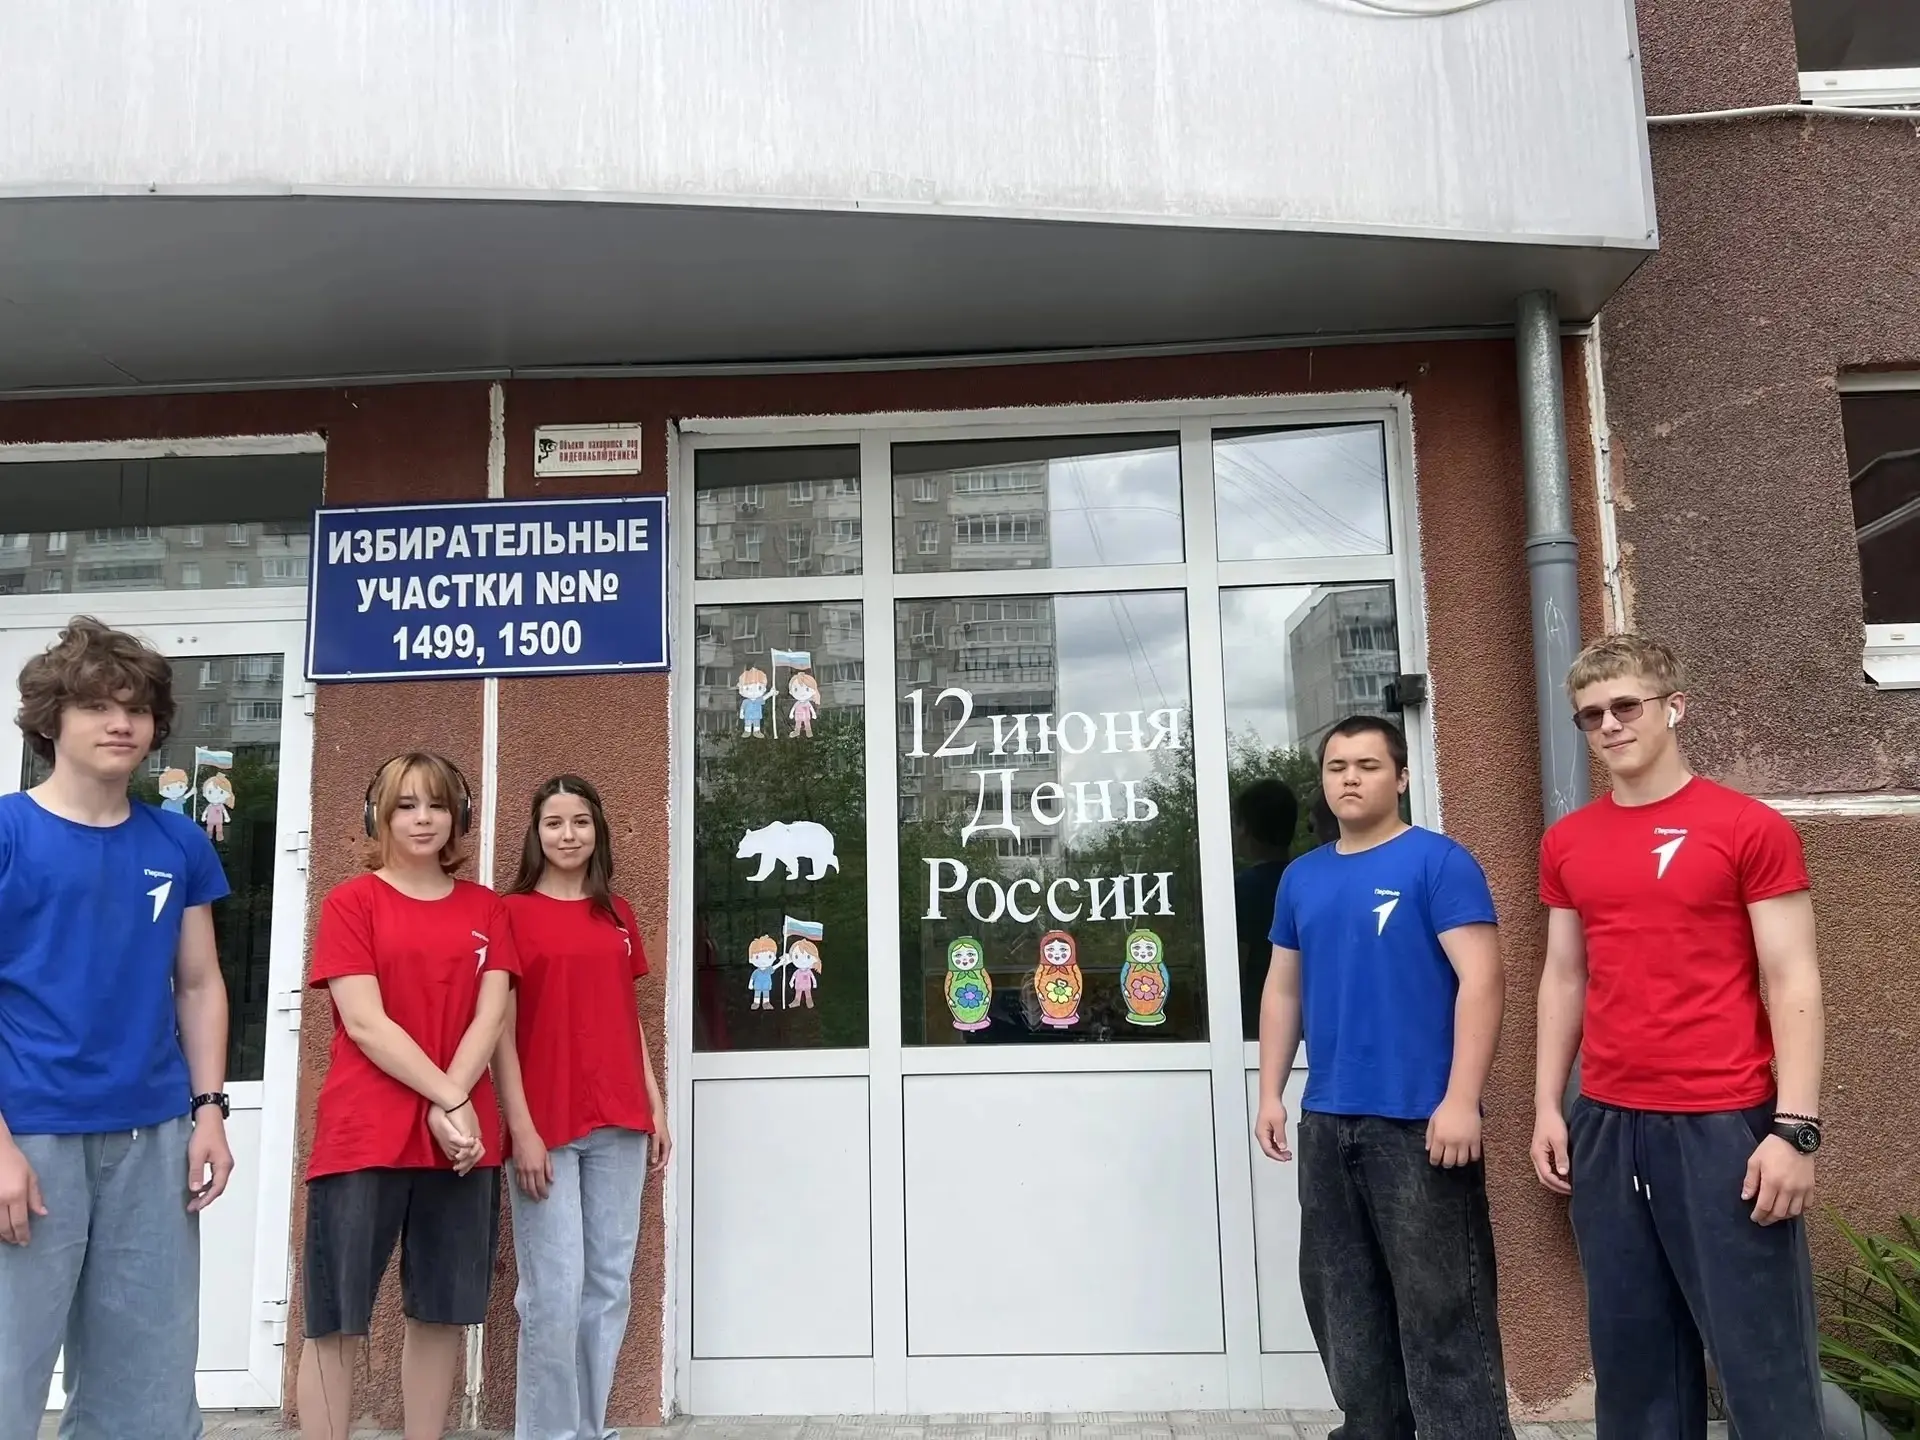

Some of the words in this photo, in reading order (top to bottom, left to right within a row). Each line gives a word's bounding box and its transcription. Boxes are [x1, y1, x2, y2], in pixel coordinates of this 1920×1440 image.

[328, 518, 649, 564] ИЗБИРАТЕЛЬНЫЕ
[357, 572, 523, 612] УЧАСТКИ
[535, 568, 619, 605] №№
[393, 624, 486, 666] 1499,
[498, 620, 582, 656] 1500
[904, 687, 977, 758] 12
[986, 707, 1185, 756] июня
[961, 767, 1160, 848] День
[920, 857, 1176, 924] России
